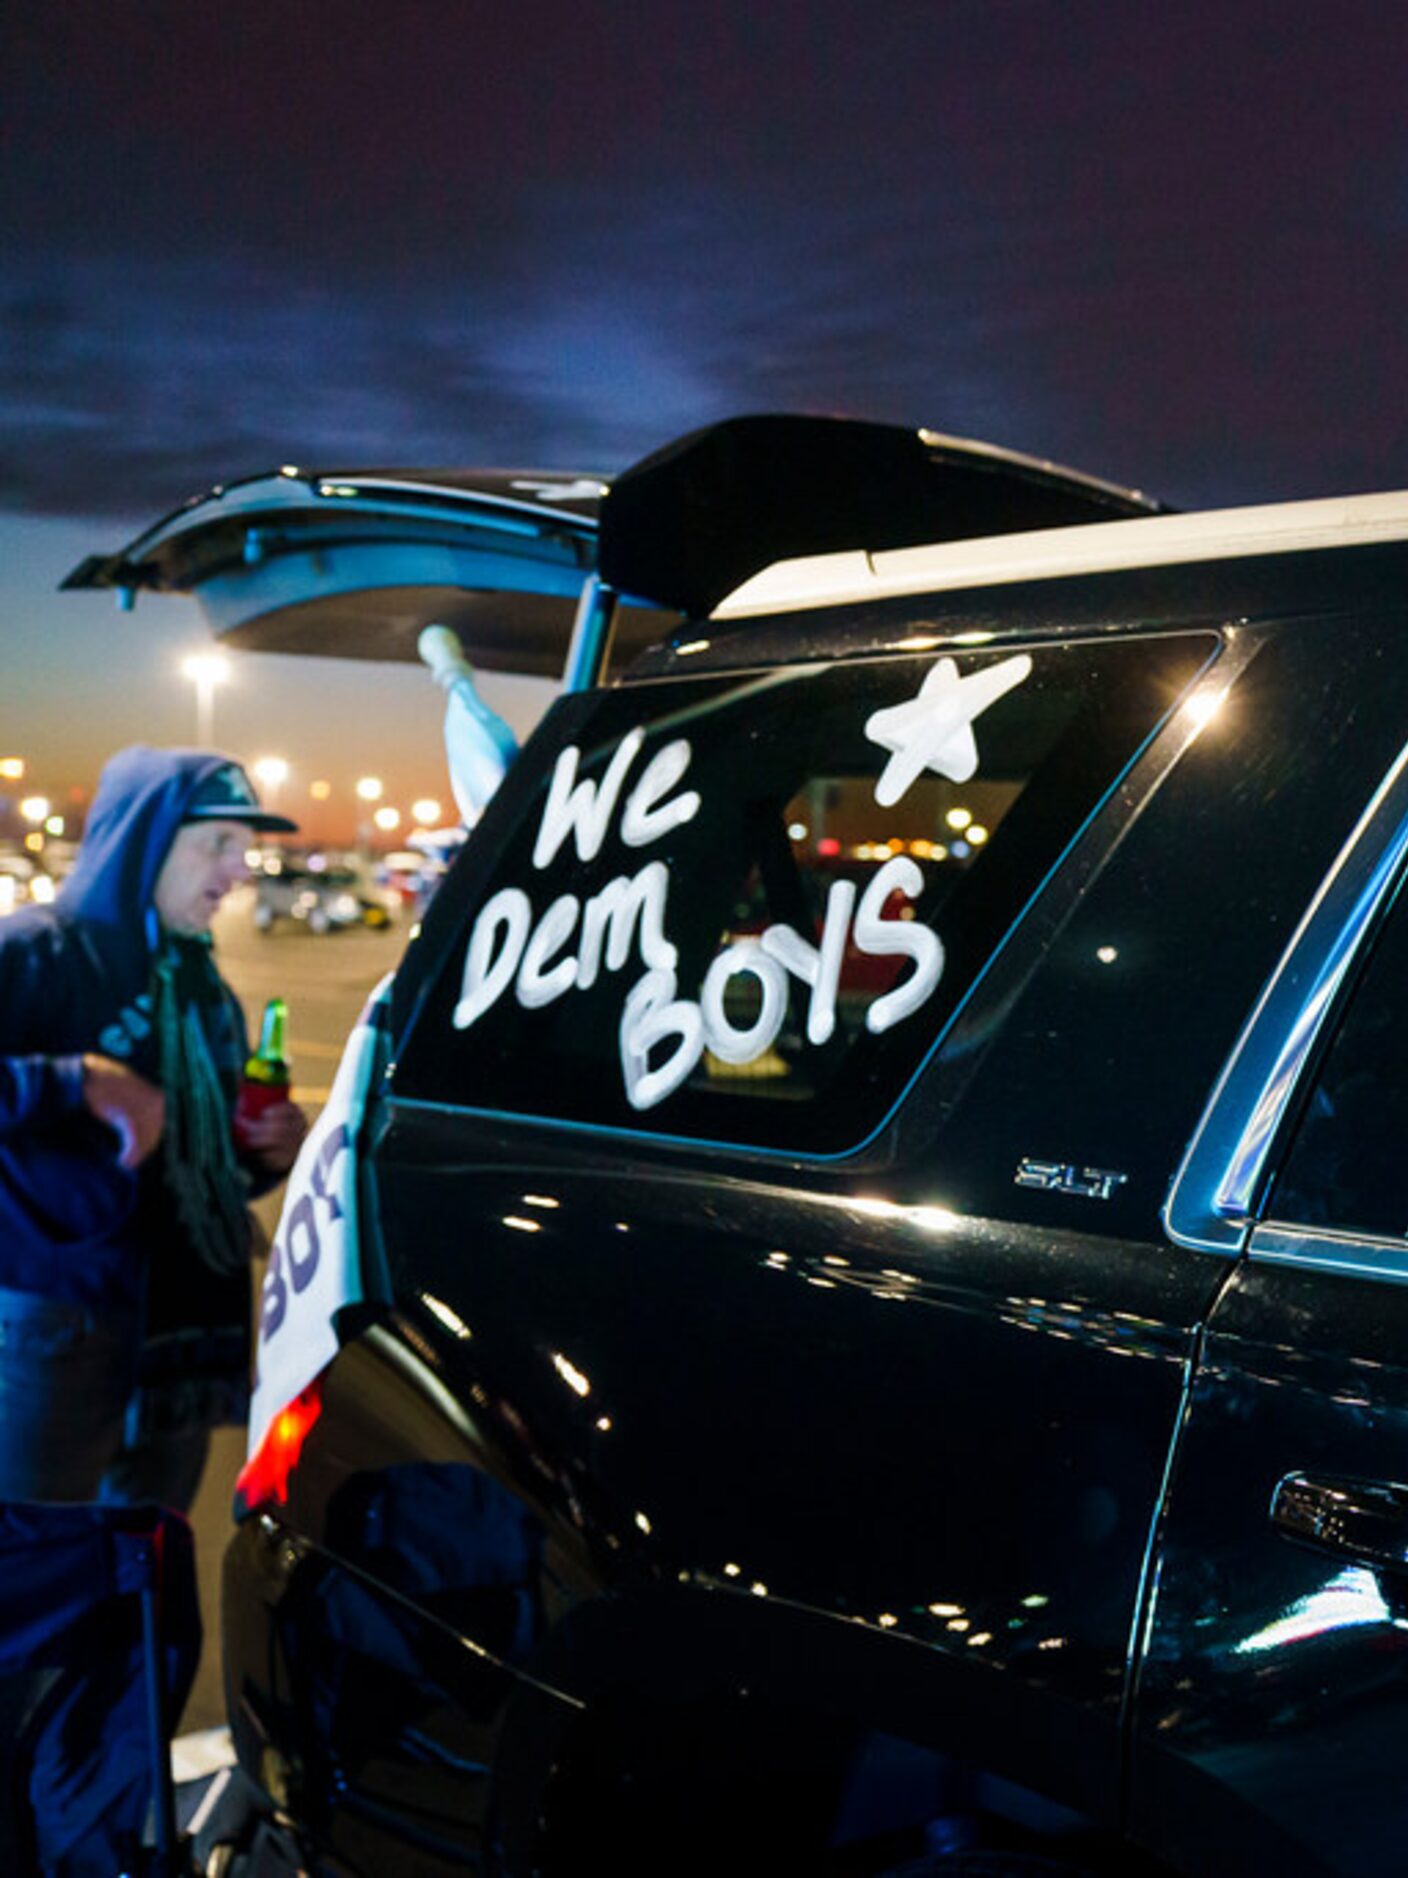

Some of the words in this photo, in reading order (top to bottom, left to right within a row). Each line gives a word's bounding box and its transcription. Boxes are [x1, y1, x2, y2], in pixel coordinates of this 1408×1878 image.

[533, 726, 702, 870] We
[452, 860, 678, 1031] Dem
[1014, 1157, 1128, 1199] SLT
